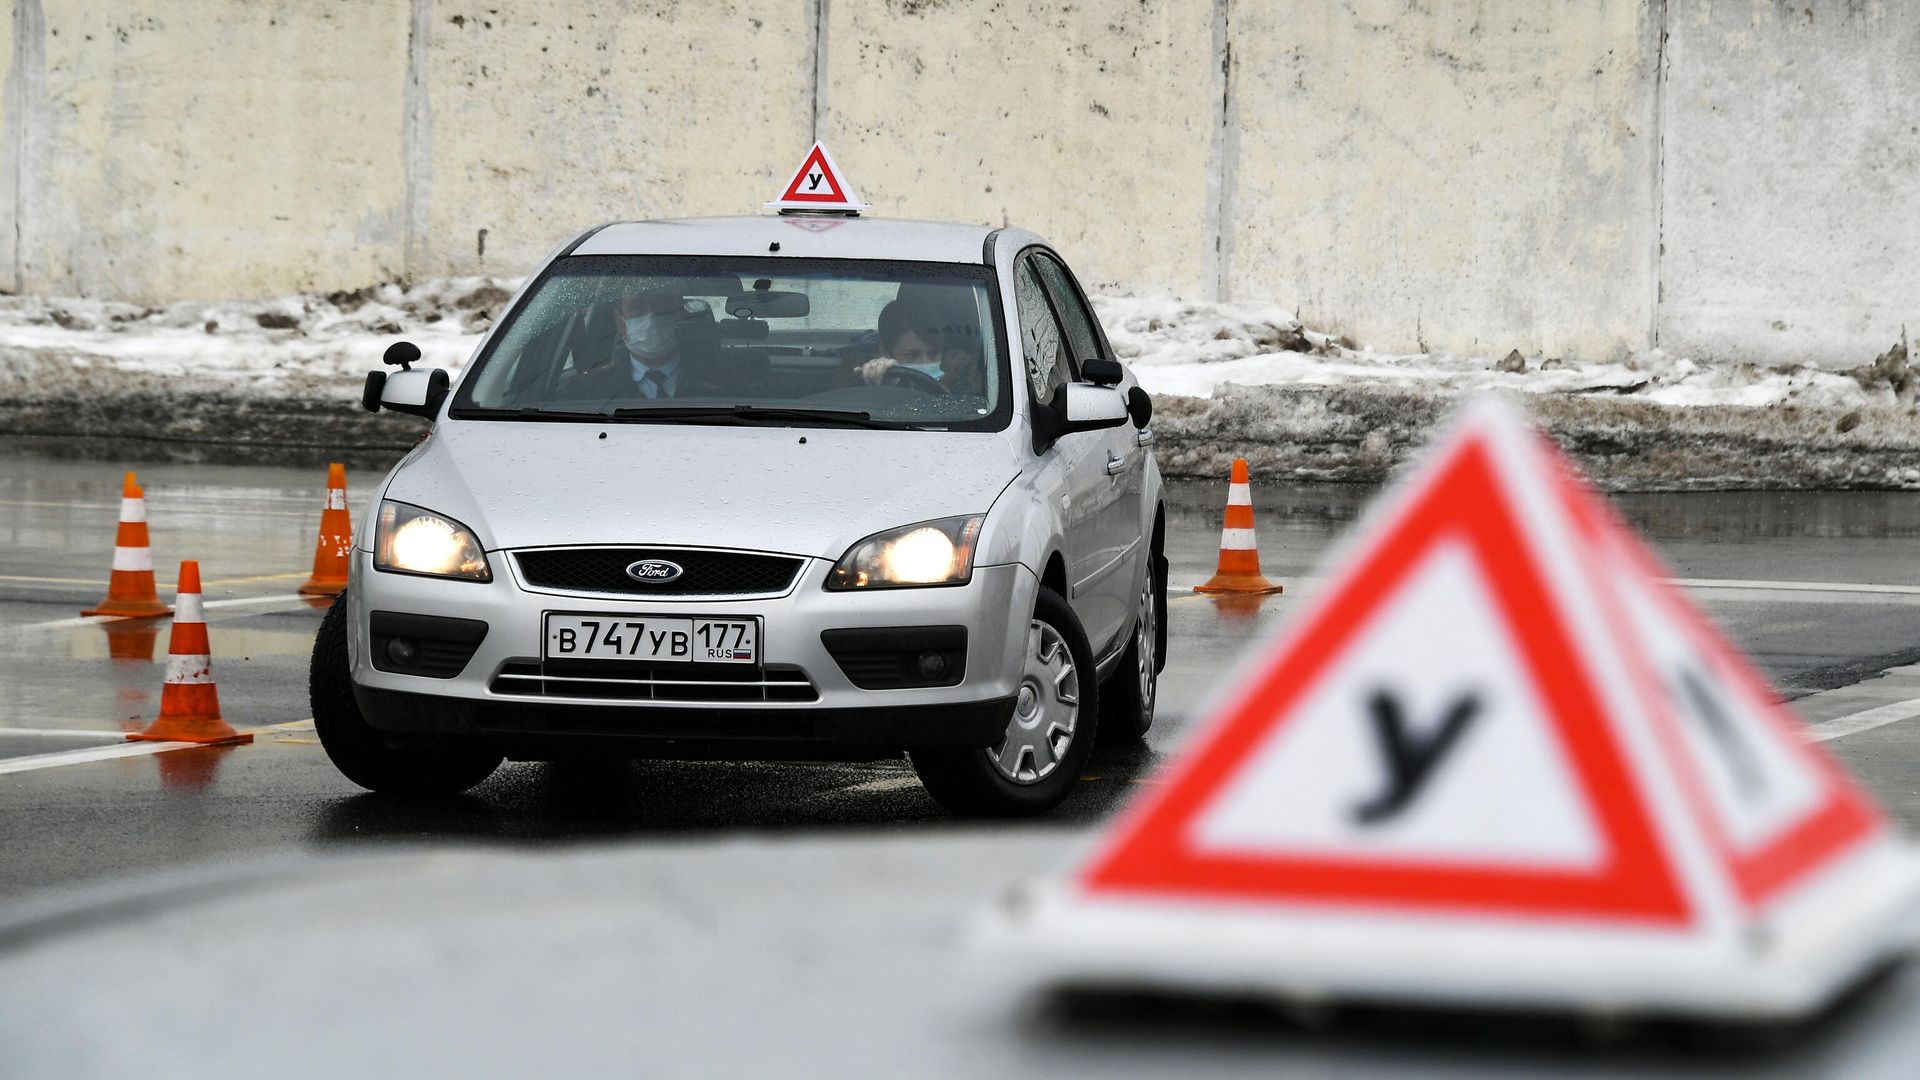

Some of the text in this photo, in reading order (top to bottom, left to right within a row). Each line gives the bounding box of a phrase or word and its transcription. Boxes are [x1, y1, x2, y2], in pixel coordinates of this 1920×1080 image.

[638, 563, 670, 577] Ford
[559, 621, 747, 656] В747УВ 177
[707, 649, 732, 658] RUS
